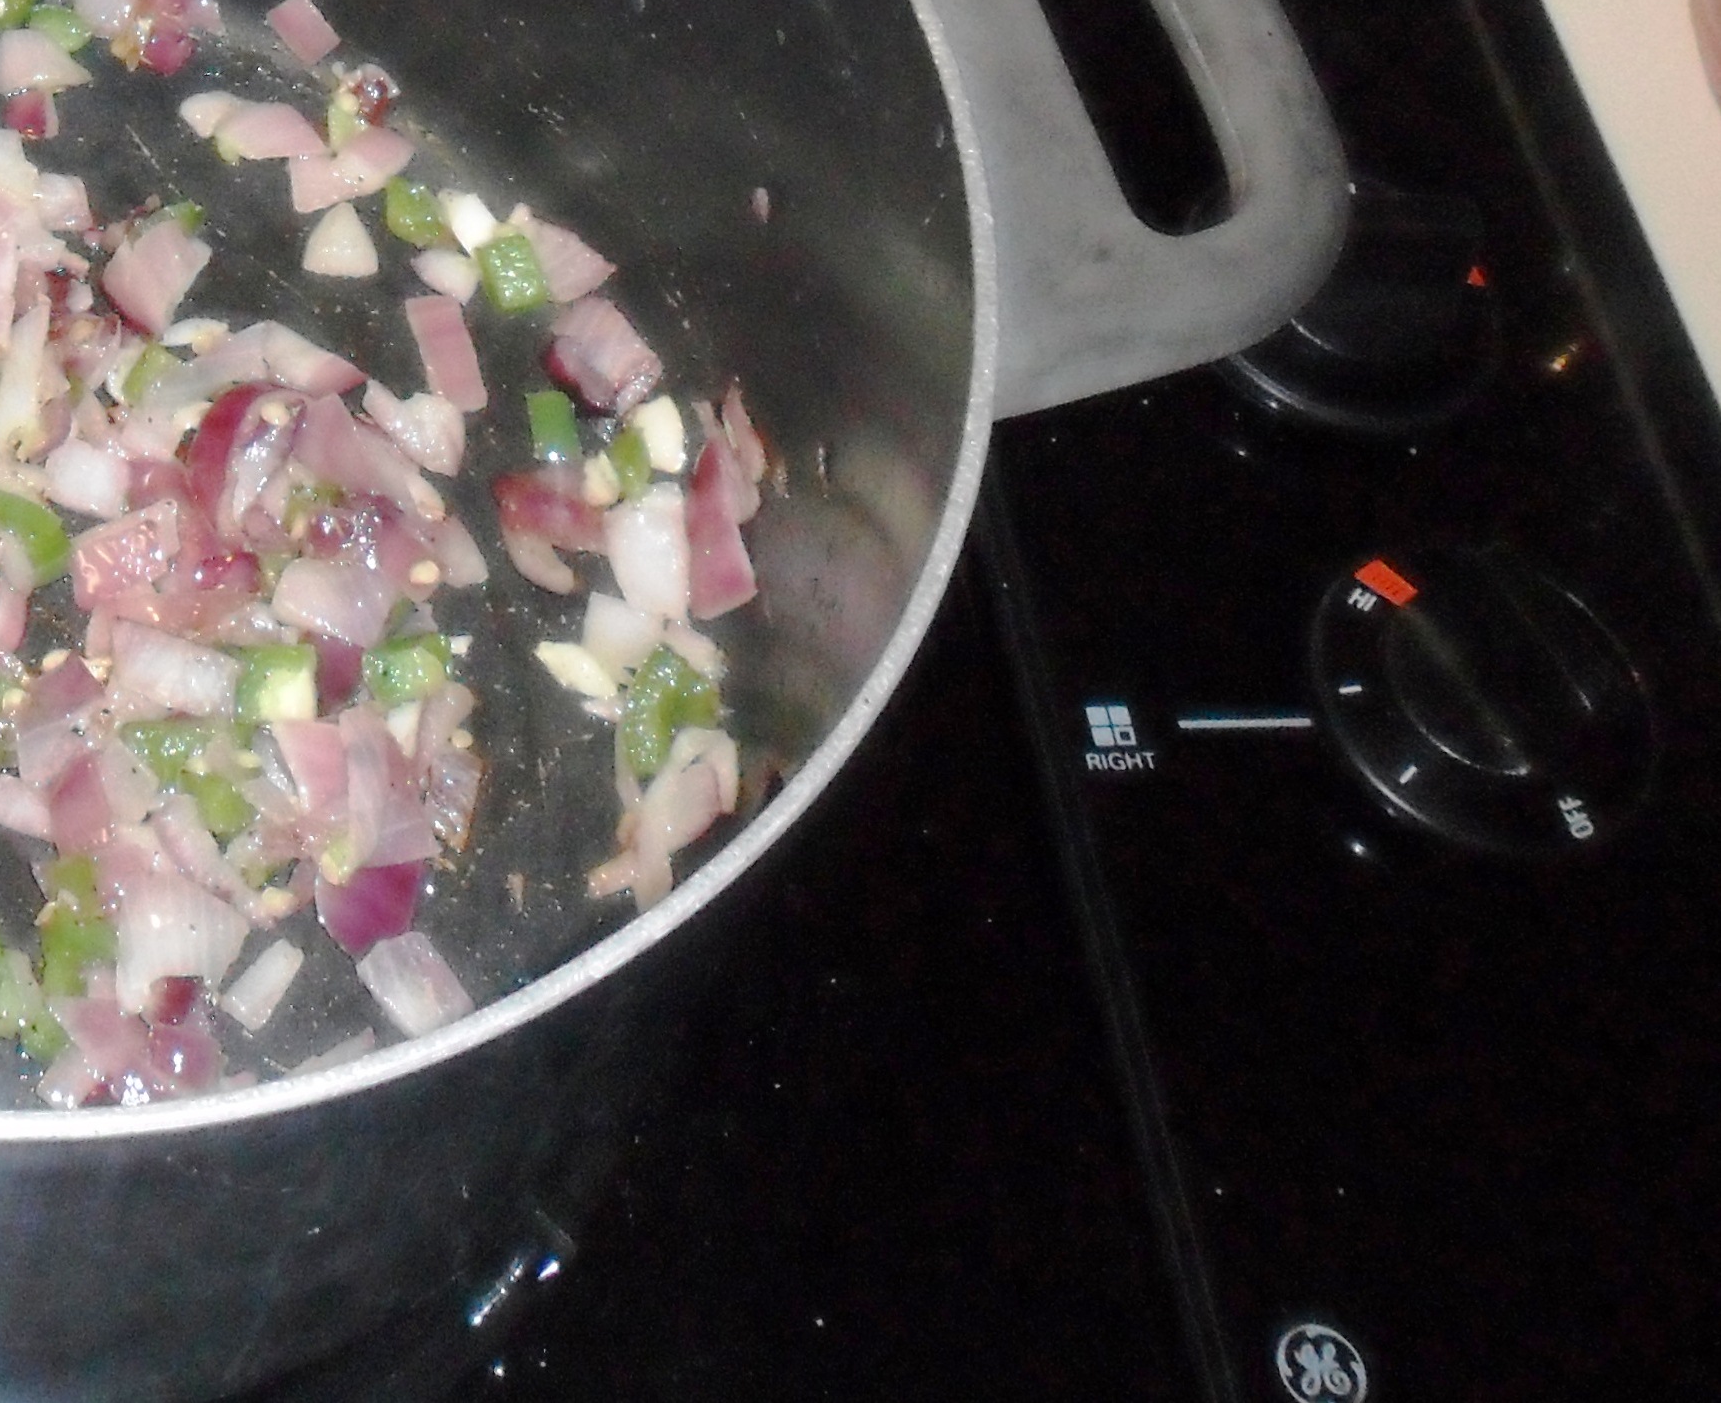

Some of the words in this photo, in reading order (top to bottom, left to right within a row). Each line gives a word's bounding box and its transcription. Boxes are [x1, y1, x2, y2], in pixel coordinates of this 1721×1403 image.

[1347, 587, 1378, 612] HI
[1085, 751, 1155, 771] RIGHT
[1558, 796, 1594, 839] OFF
